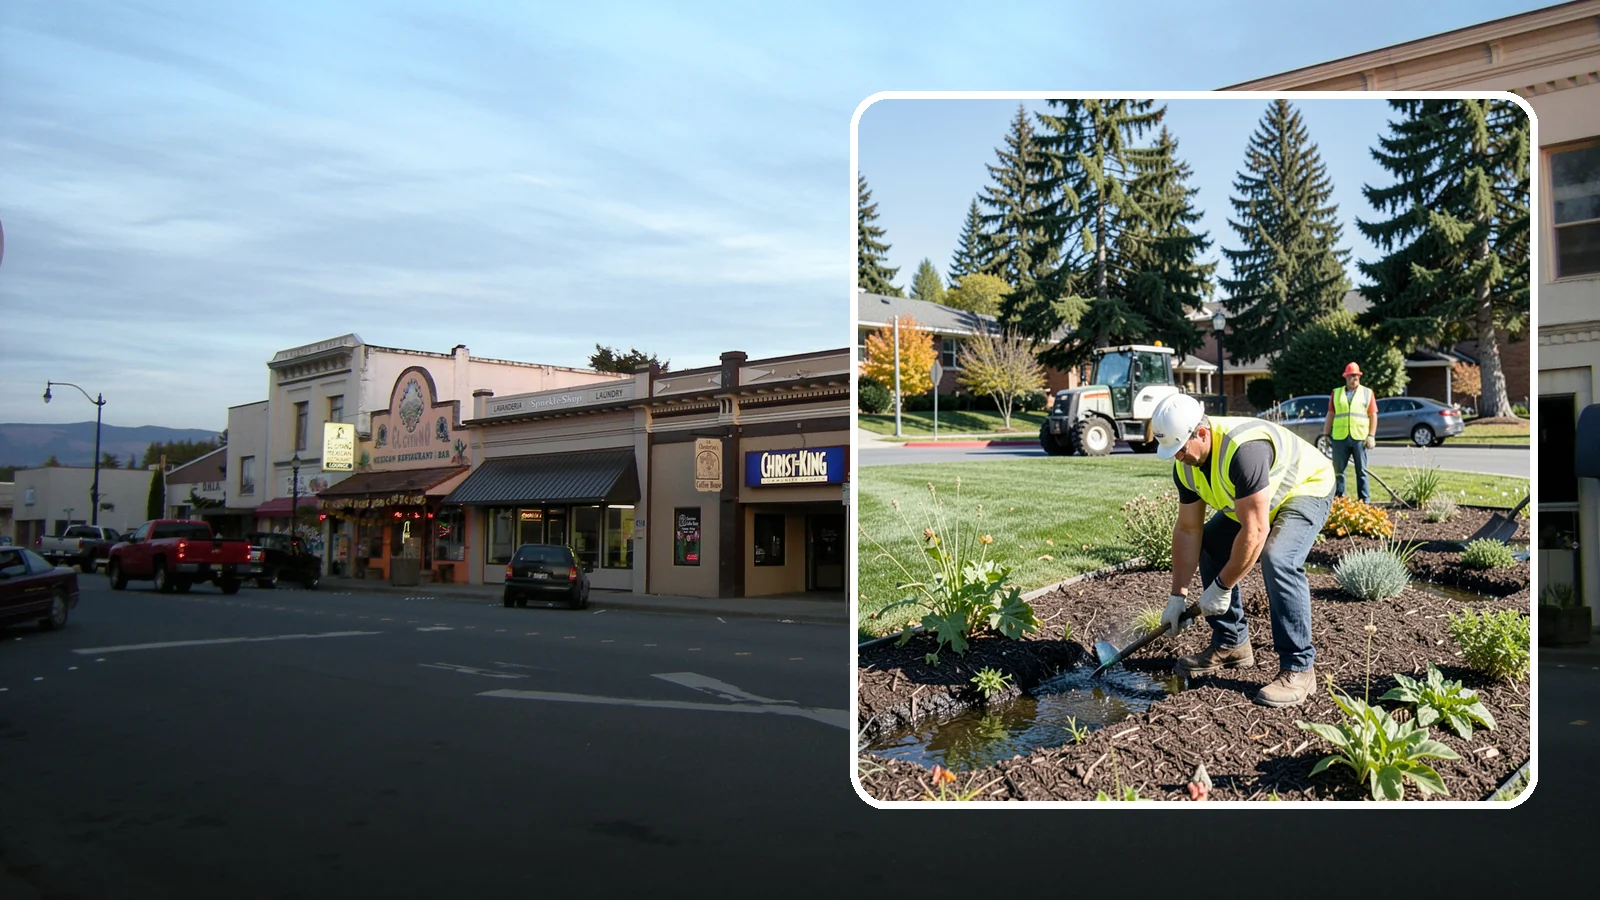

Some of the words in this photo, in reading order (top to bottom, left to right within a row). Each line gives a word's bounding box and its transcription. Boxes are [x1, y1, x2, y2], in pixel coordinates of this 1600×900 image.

[595, 389, 623, 400] LAUNDRY
[493, 402, 522, 412] LAVANDERIA
[530, 398, 561, 409] Sparkle
[561, 394, 582, 405] Shop
[373, 455, 396, 464] MEXICAN
[397, 451, 434, 462] RESTAURANT
[437, 449, 450, 459] BAR
[761, 452, 797, 478] CHRIST
[799, 450, 827, 476] KING
[696, 481, 709, 489] Coffee
[710, 480, 722, 489] House
